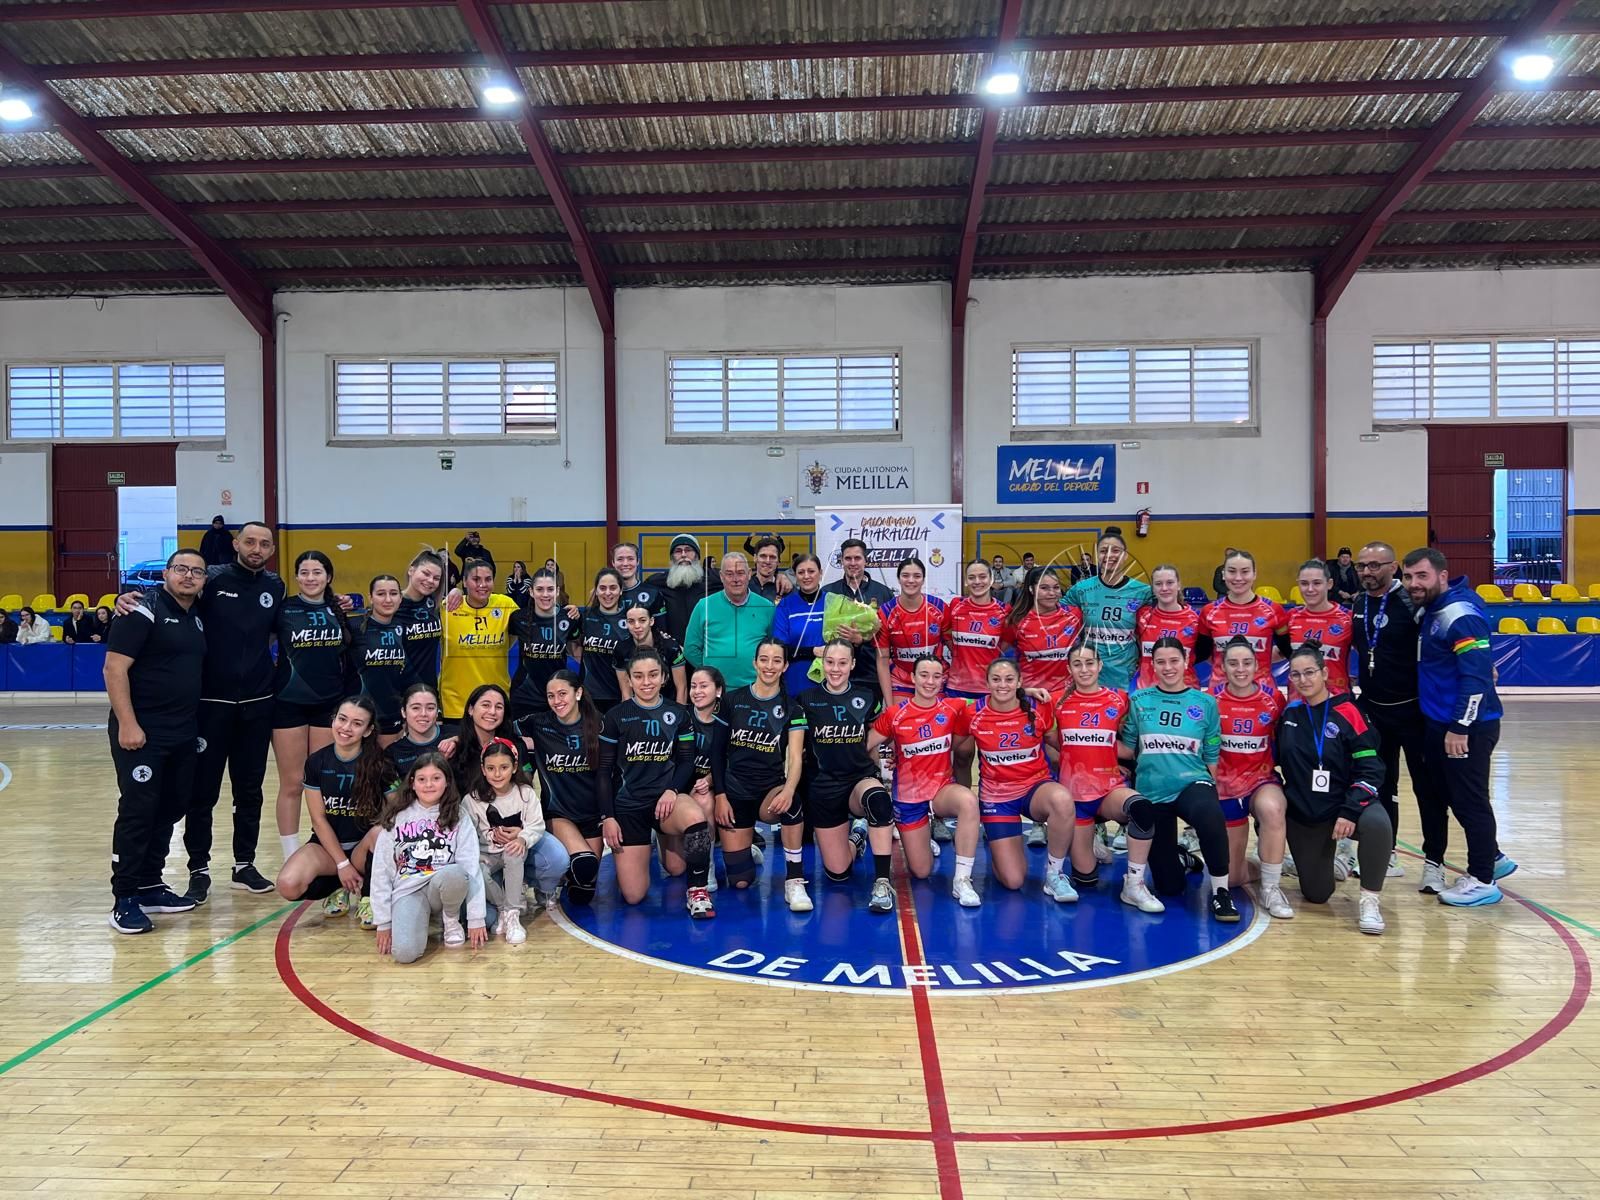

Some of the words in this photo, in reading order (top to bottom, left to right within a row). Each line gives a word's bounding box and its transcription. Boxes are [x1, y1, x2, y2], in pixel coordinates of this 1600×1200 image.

[835, 465, 862, 474] CIUDAD
[863, 465, 909, 473] AUTÓNOMA
[1008, 456, 1105, 482] MELILLA
[836, 475, 909, 490] MELILLA
[1009, 482, 1042, 492] CIUDAD
[1044, 482, 1060, 491] DEL
[1063, 481, 1100, 491] DEPORTE
[306, 612, 327, 626] 33
[1102, 606, 1122, 621] 69
[405, 619, 442, 635] MELILL
[474, 617, 488, 631] 21
[603, 623, 610, 635] 9
[969, 621, 983, 632] 10
[1229, 622, 1249, 634] 39
[291, 628, 343, 643] MELILLA
[381, 631, 395, 645] 28
[458, 632, 505, 645] MELILLA
[540, 627, 553, 640] 10
[912, 632, 921, 645] 3
[1303, 629, 1322, 640] 44
[1046, 635, 1057, 648] 11
[365, 649, 406, 661] MELILL
[748, 709, 768, 728] 22
[832, 705, 847, 722] 12
[1080, 713, 1099, 727] 24
[1159, 711, 1182, 728] 96
[642, 719, 660, 737] 70
[814, 723, 866, 738] MELILLA
[918, 724, 932, 739] 18
[1232, 719, 1254, 734] 59
[730, 728, 780, 747] MELILLA
[999, 733, 1020, 748] 22
[1064, 733, 1105, 743] helvetia
[625, 741, 673, 756] MELILLA
[904, 743, 942, 756] helvetia
[545, 753, 589, 768] MELILL
[985, 753, 1027, 765] helvetia
[336, 774, 355, 792] 77
[707, 948, 809, 977] DE
[821, 949, 1122, 987] MELILLA
